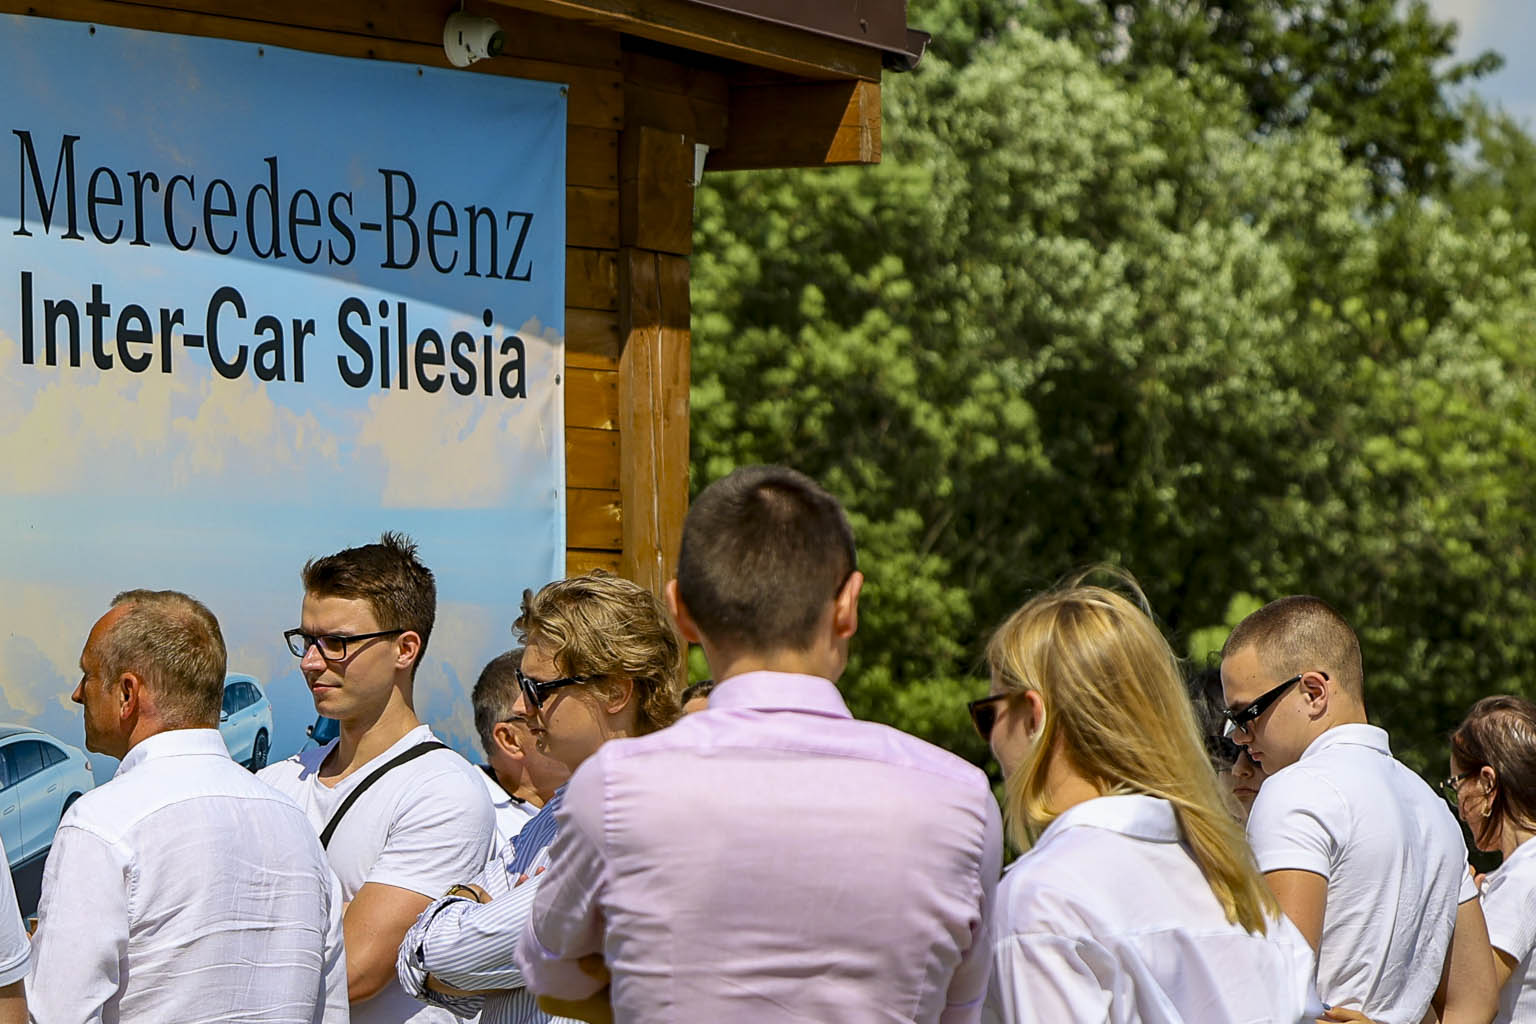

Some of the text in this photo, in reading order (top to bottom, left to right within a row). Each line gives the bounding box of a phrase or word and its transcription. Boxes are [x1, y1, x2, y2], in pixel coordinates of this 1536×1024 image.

[13, 129, 535, 281] Mercedes-Benz
[21, 271, 527, 399] Inter-Car Silesia
